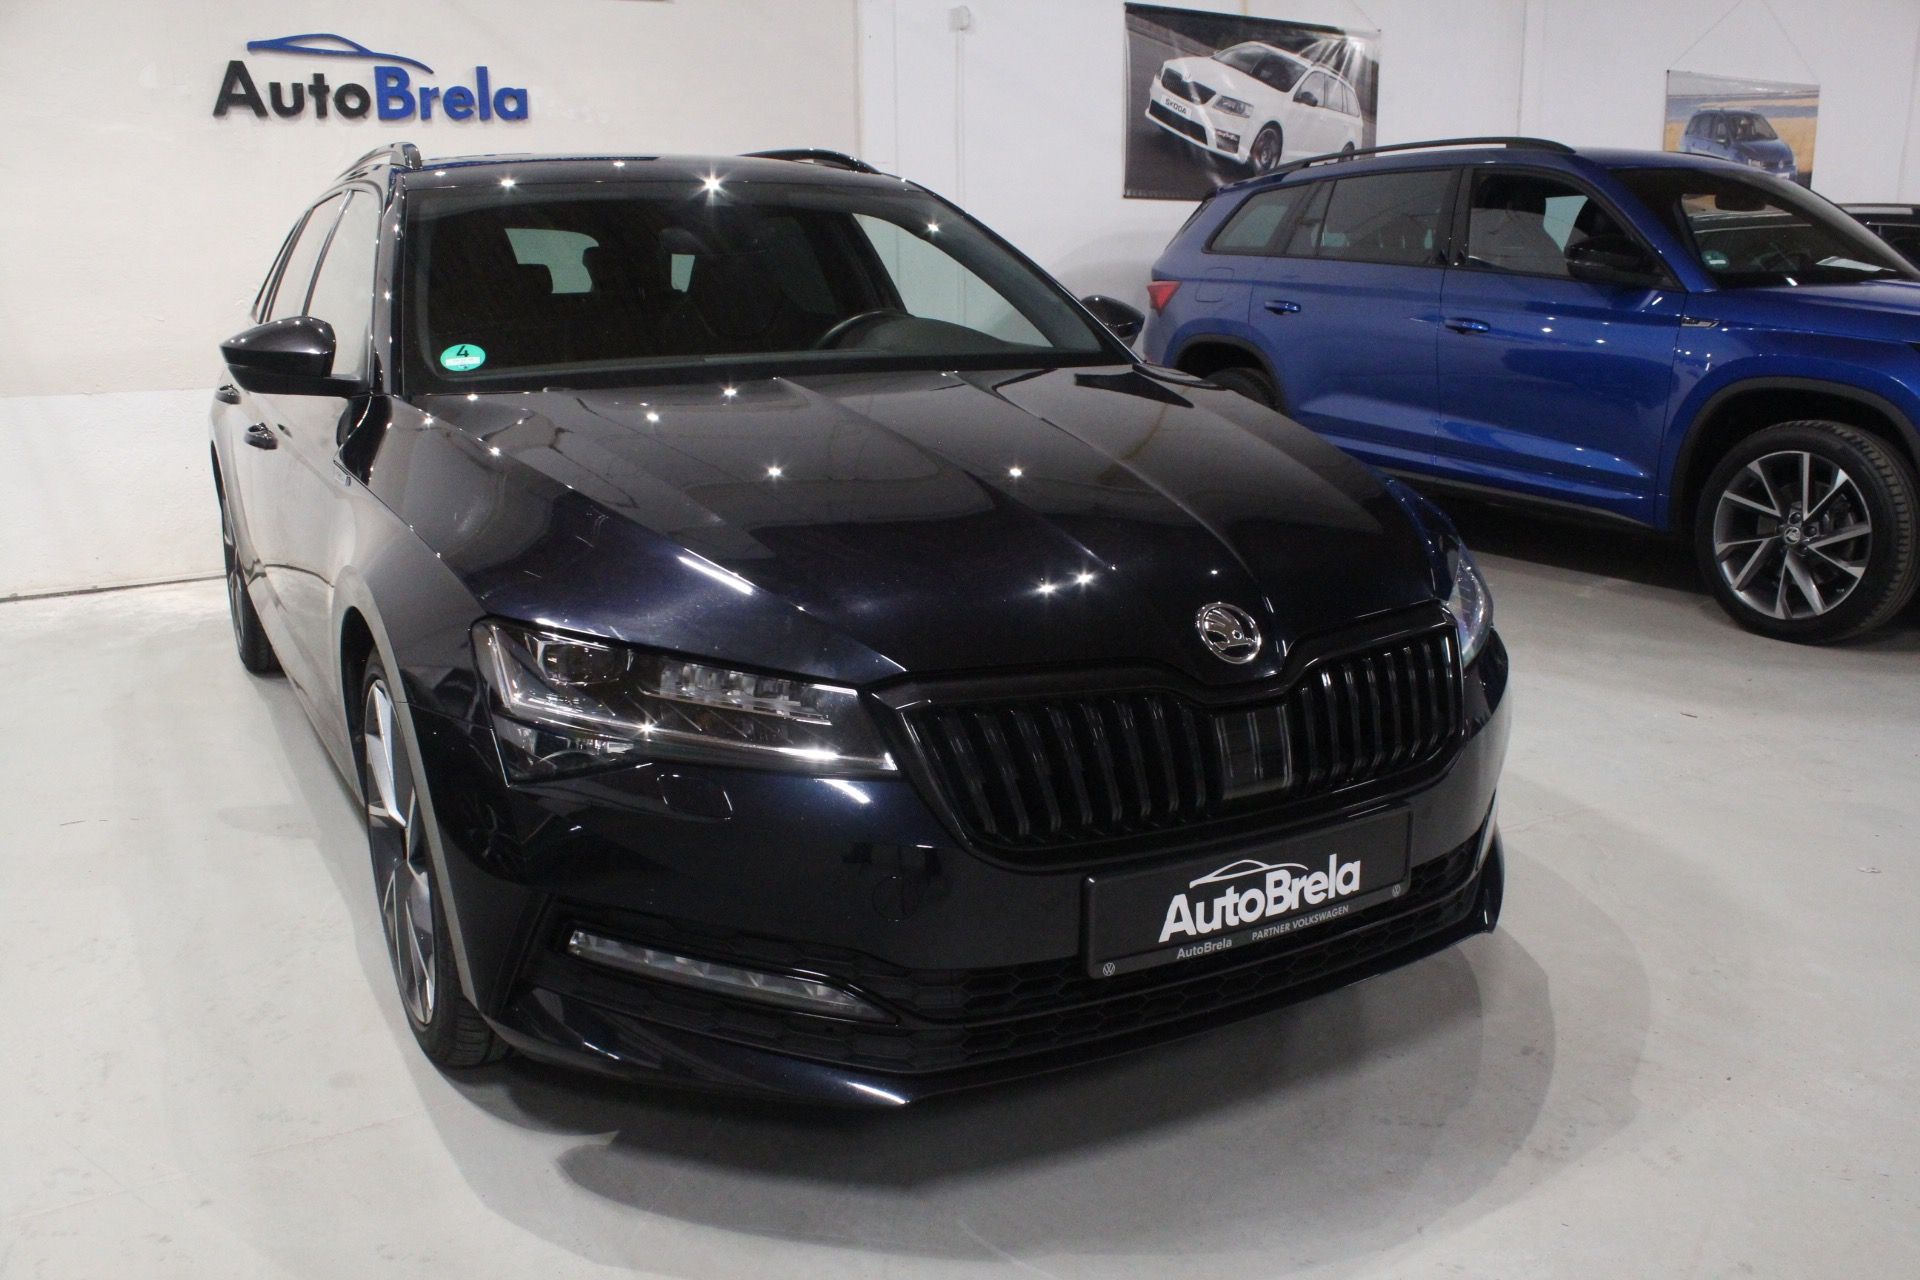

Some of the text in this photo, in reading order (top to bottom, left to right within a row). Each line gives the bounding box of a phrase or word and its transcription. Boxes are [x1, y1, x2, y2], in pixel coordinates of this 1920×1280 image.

[213, 60, 528, 121] AutoBrela
[456, 345, 469, 357] 4
[1158, 853, 1361, 943] AutoBrela
[1251, 905, 1349, 941] PARTNER VOLKSWAGEN
[1177, 938, 1232, 959] AutoBrela
